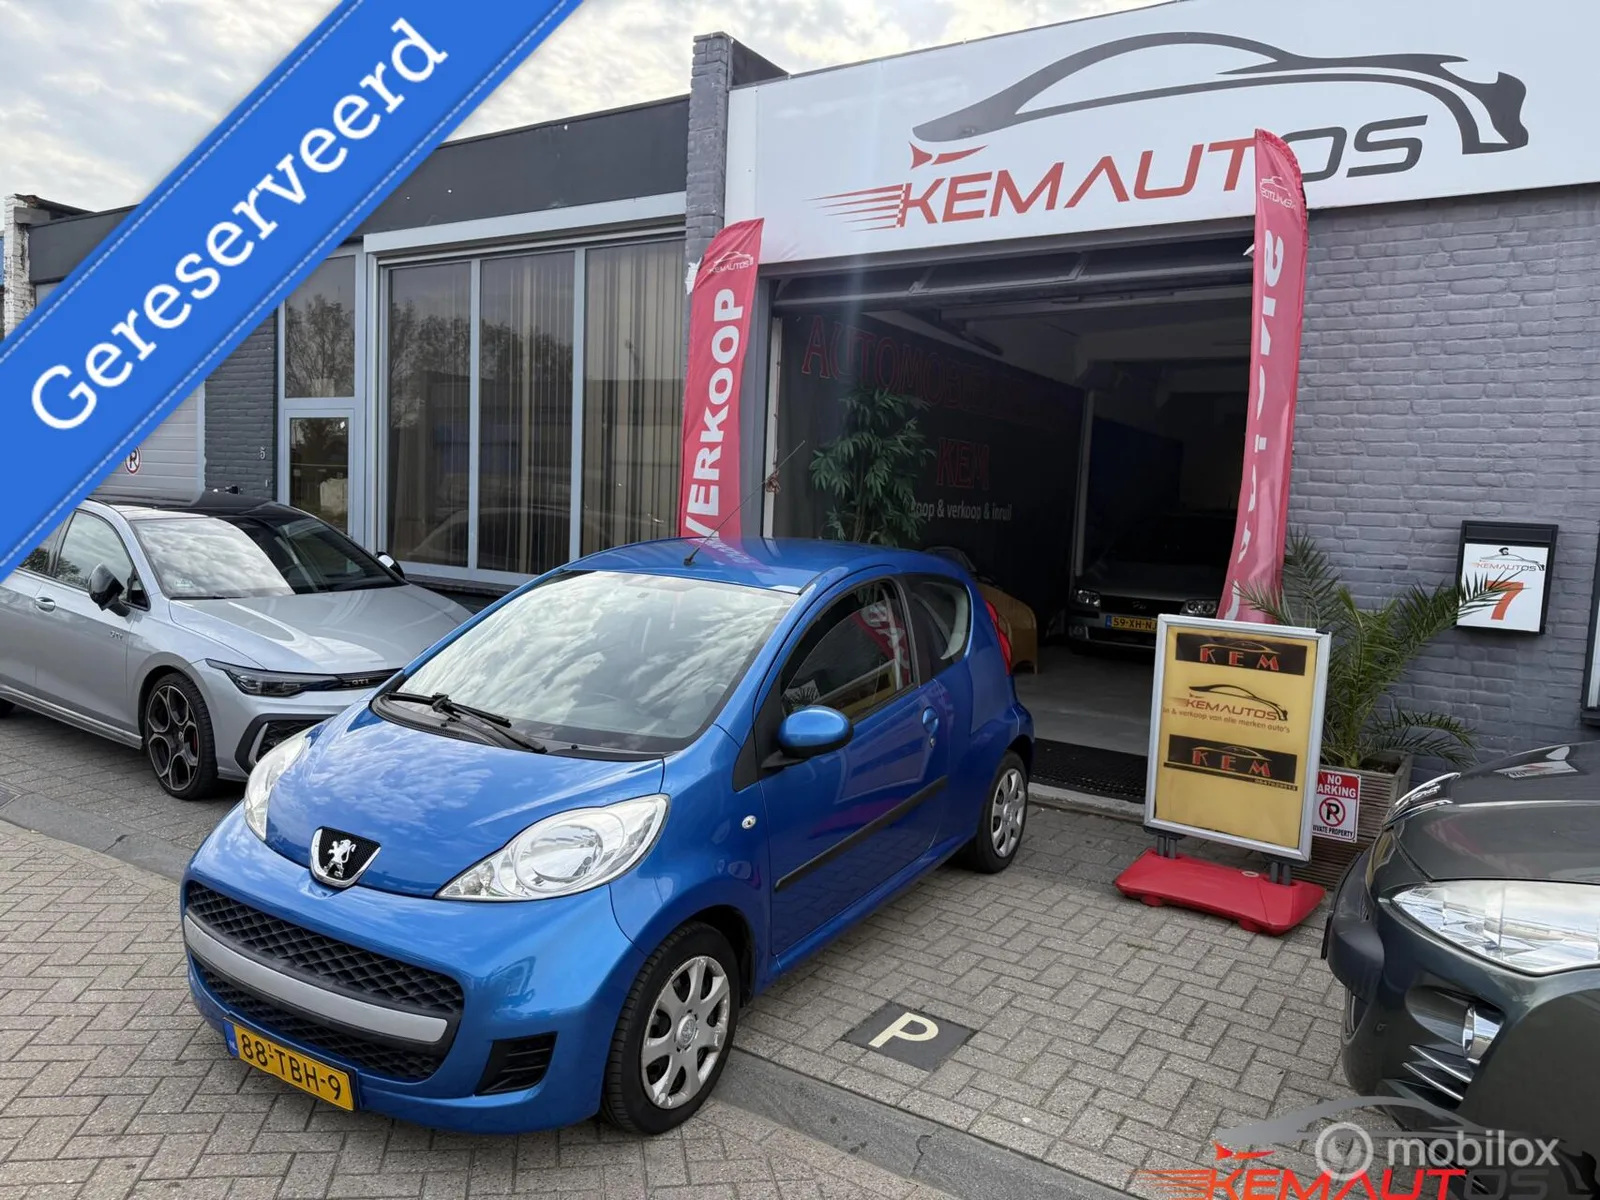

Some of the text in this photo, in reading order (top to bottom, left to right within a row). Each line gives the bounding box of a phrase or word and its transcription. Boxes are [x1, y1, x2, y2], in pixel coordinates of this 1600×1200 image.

[897, 113, 1429, 229] KEMAUTOS
[935, 437, 990, 490] KEM
[937, 499, 945, 517] &
[947, 500, 981, 523] verkoop
[1477, 563, 1536, 571] KEMAUTOS
[1484, 580, 1525, 621] 7
[1199, 646, 1280, 672] KEM
[1178, 709, 1207, 720] verkoop
[1238, 719, 1266, 729] merken
[1267, 723, 1290, 734] auto's
[1184, 699, 1278, 720] KEMAUTOS
[1191, 749, 1272, 778] KEM
[1317, 783, 1356, 798] ARKING
[1327, 774, 1342, 786] NO
[1329, 827, 1353, 837] PROPERTY
[868, 1012, 939, 1048] P
[241, 1033, 341, 1101] 88-TBH-9
